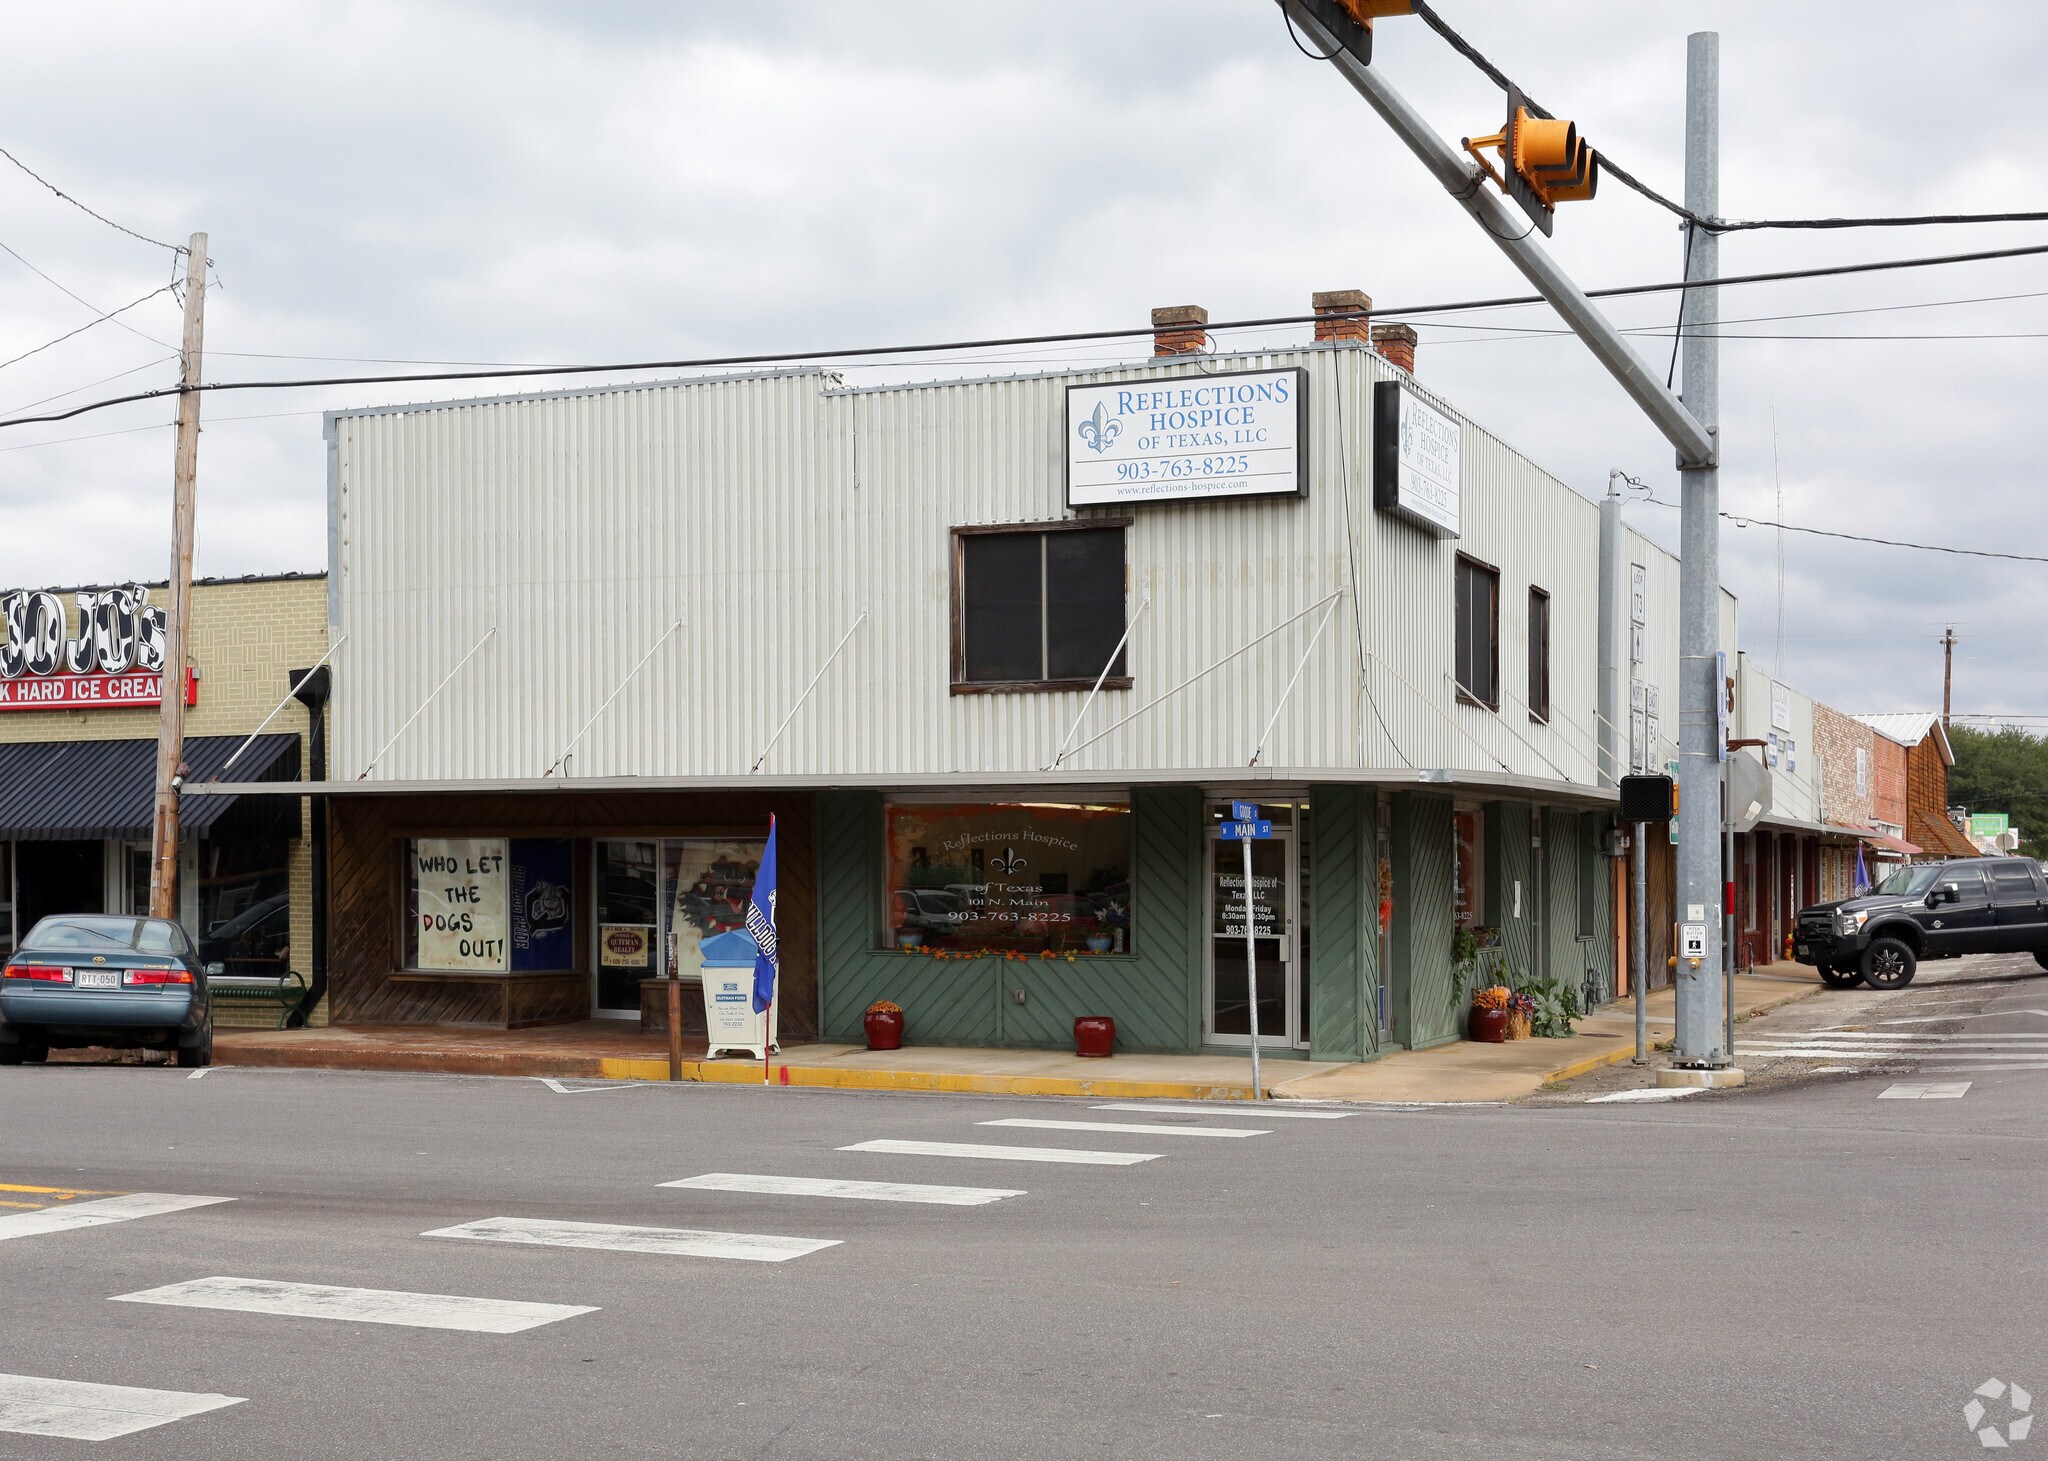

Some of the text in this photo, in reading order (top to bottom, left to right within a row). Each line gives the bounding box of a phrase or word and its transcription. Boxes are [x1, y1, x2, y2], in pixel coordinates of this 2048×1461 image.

[1117, 378, 1289, 416] REFLECTIONS
[1150, 406, 1255, 431] HOSPICE
[1411, 401, 1458, 453] REFLECTIONS
[1137, 428, 1268, 450] OF TEXAS, LLC
[1420, 431, 1449, 464] HOSPICE
[1116, 455, 1249, 481] 903-763-8225
[1117, 479, 1249, 496] www.reflections-hospice.com
[17, 681, 65, 700] HARD
[72, 679, 101, 699] ICE
[1222, 823, 1269, 837] N MAIN ST
[943, 830, 1079, 851] Reflections Hospice
[419, 855, 504, 874] WHO LET
[975, 882, 1043, 895] of Texas
[1219, 876, 1278, 890] Reflection ospice of
[445, 885, 481, 903] THE
[969, 898, 984, 906] 101
[1010, 898, 1049, 906] Main
[1231, 891, 1266, 900] Texa LLC
[948, 911, 1071, 922] 903-763-8225
[1224, 904, 1247, 912] Monda
[423, 912, 474, 932] DOGS
[459, 938, 504, 964] OUT!
